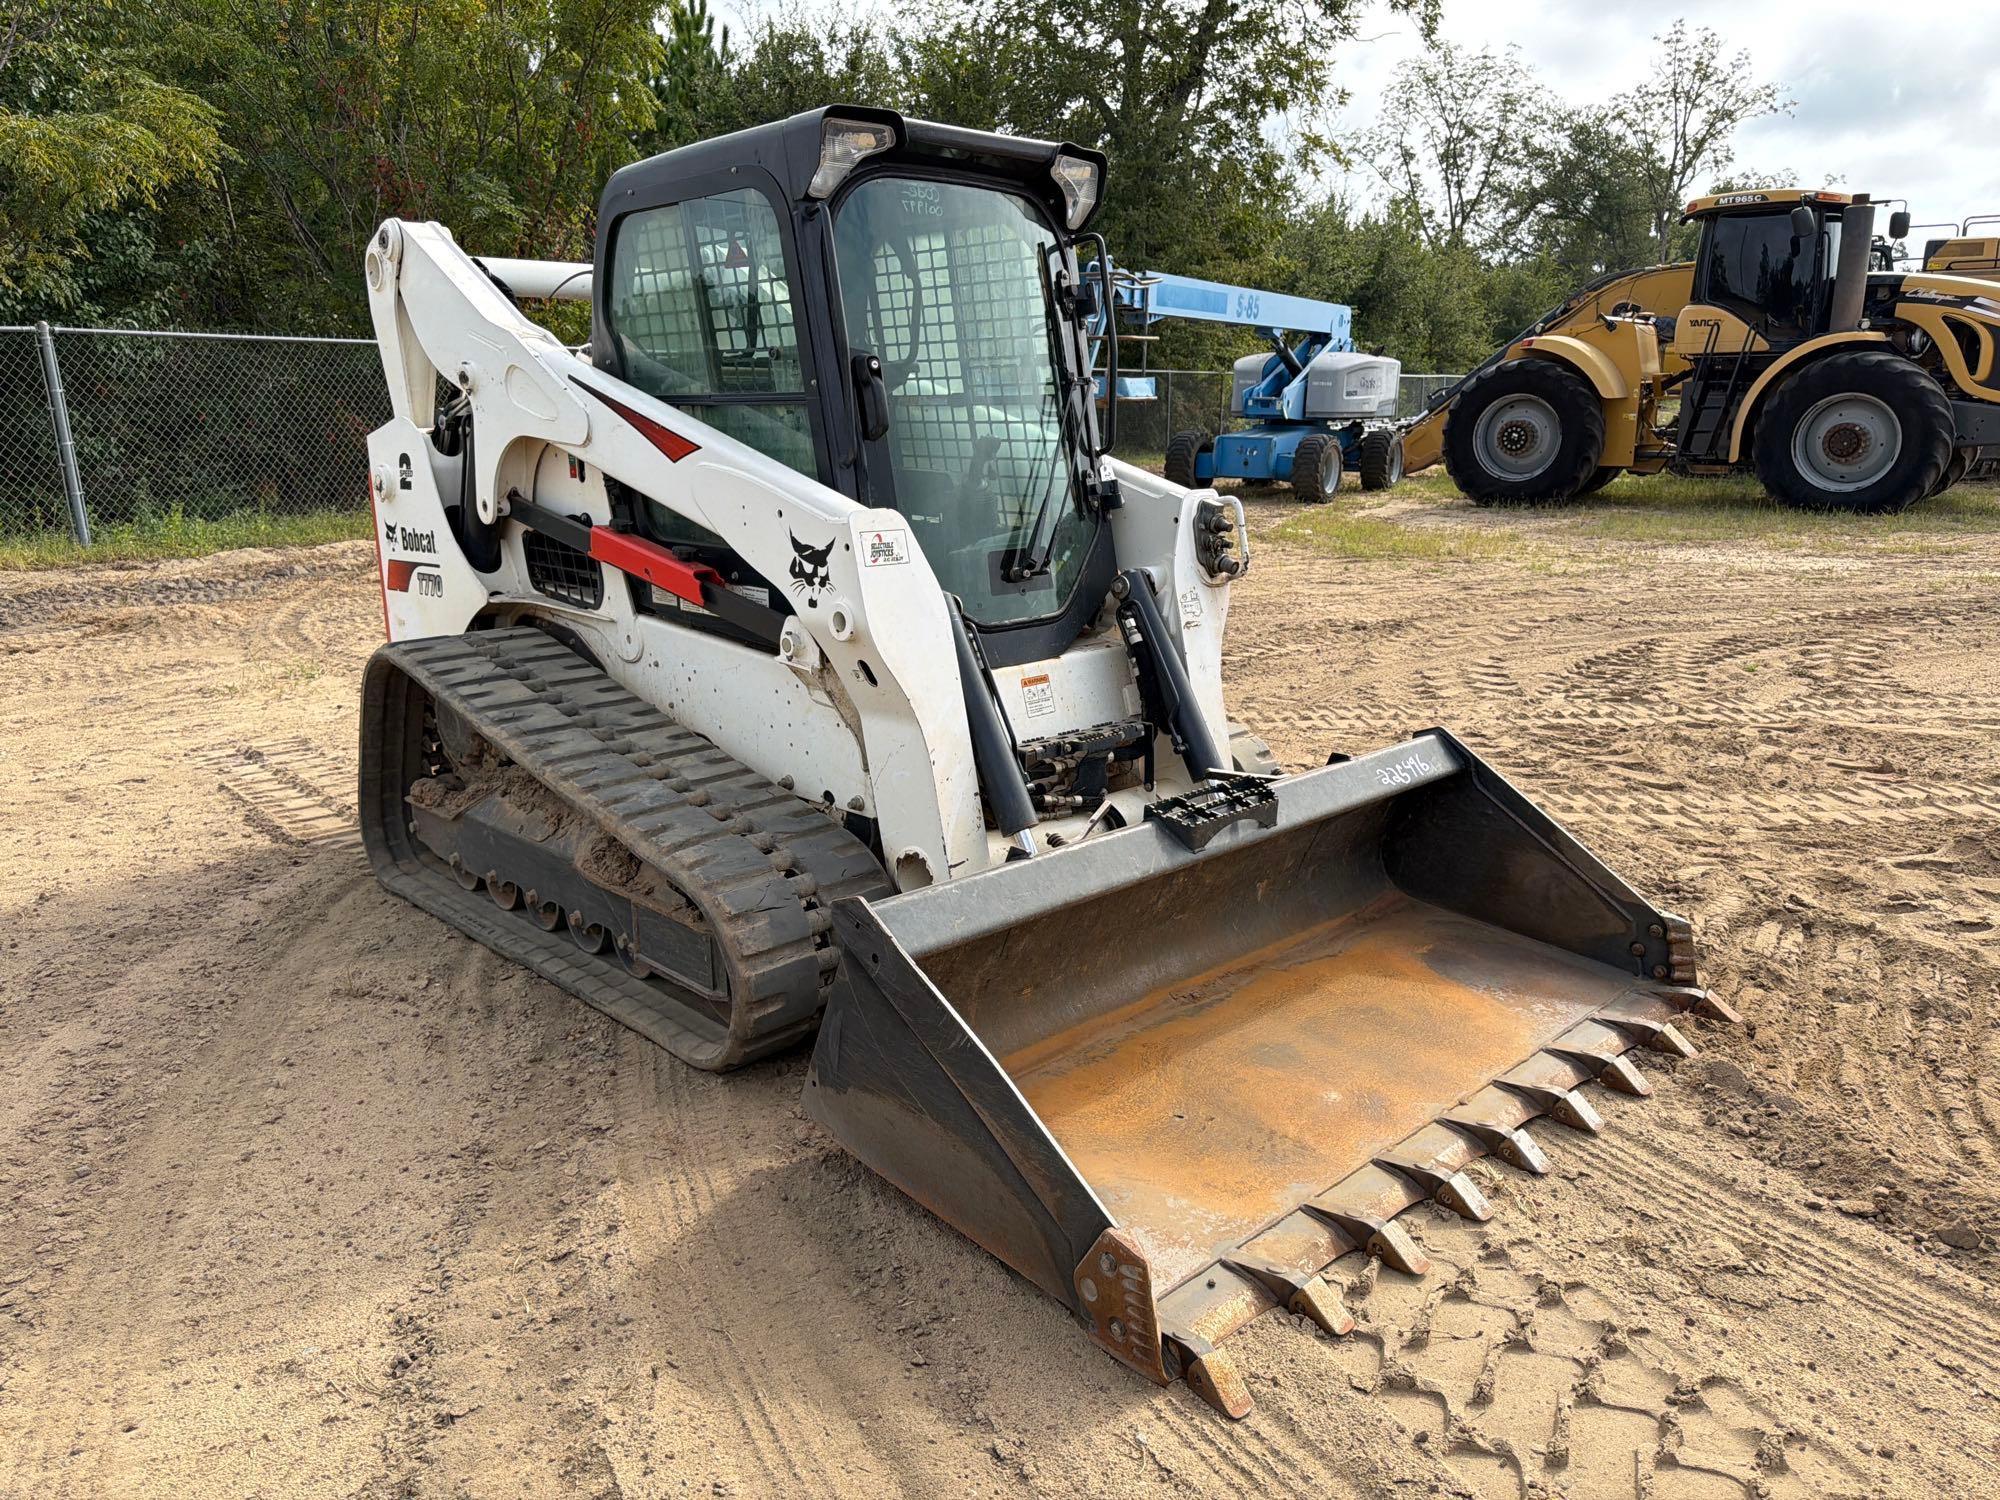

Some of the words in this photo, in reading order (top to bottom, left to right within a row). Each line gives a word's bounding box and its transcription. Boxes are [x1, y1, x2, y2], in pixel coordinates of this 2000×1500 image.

[400, 526, 437, 554] Bobcat
[416, 571, 444, 598] T770
[1376, 753, 1430, 785] 225496
